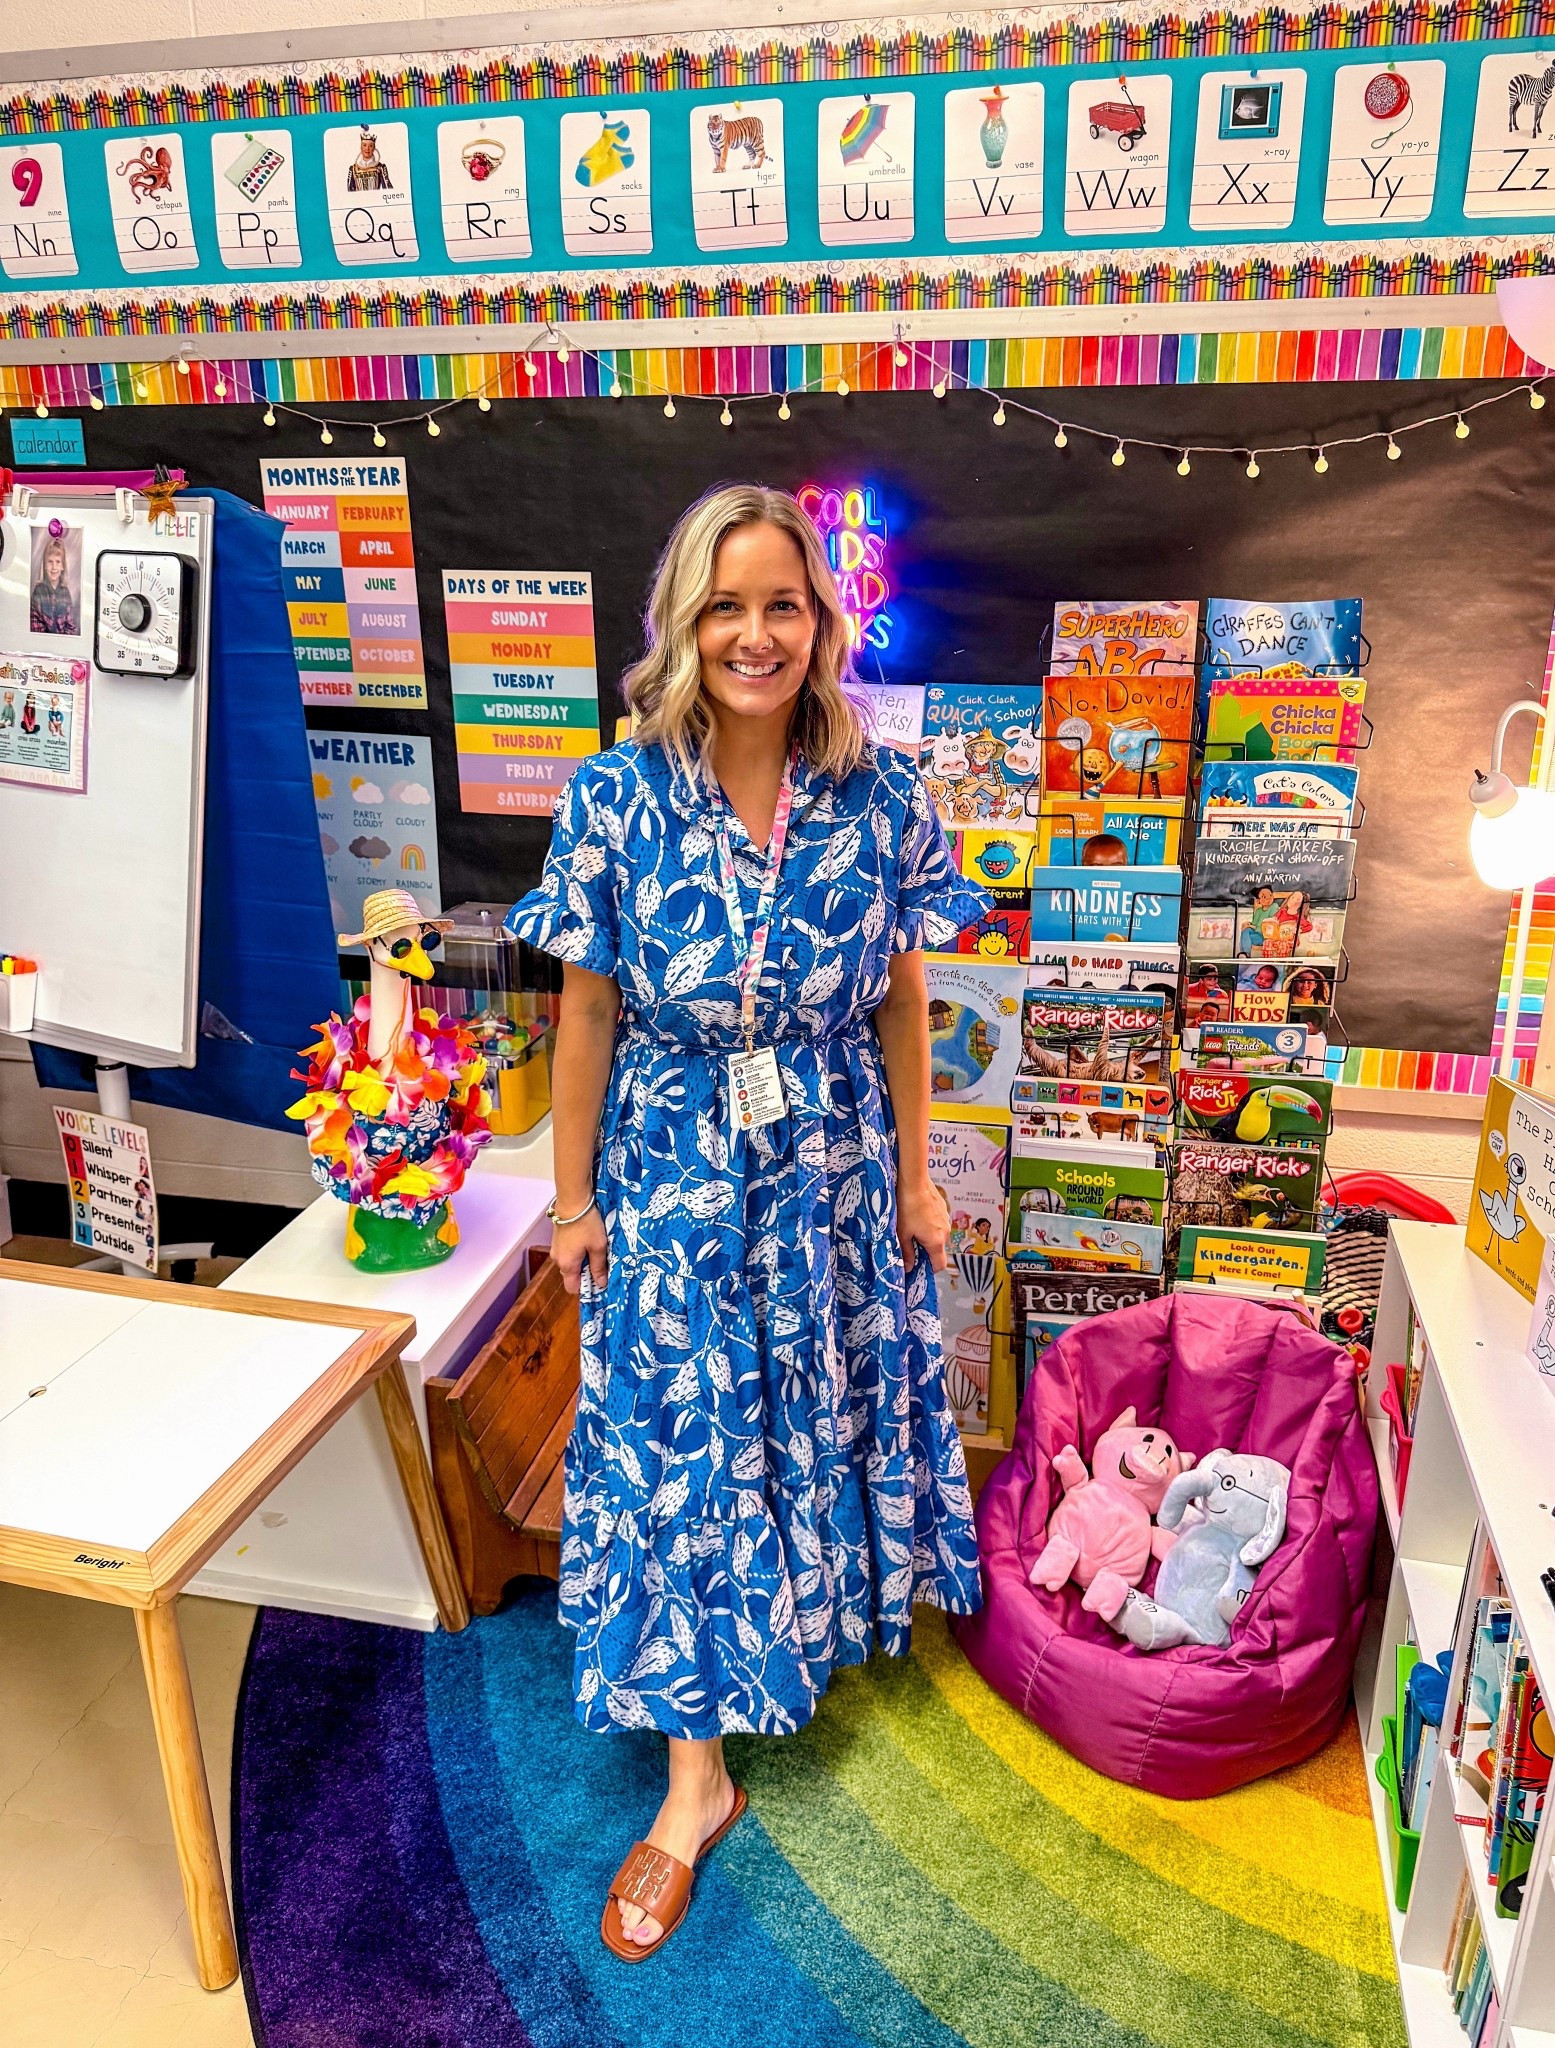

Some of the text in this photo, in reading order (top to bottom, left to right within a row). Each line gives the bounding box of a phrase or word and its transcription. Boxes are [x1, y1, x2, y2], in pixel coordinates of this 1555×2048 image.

[1401, 140, 1430, 151] yo-yo
[1129, 153, 1159, 164] wagon
[1264, 148, 1290, 159] x-ray
[869, 165, 906, 175] umbrella
[1015, 160, 1034, 170] vase
[1498, 149, 1549, 191] Zz
[756, 171, 777, 184] tiger
[1218, 164, 1269, 204] Xx
[505, 187, 520, 198] ring
[621, 181, 643, 190] socks
[1077, 169, 1156, 210] Ww
[1361, 157, 1403, 217] Yy
[268, 198, 289, 208] paints
[383, 192, 405, 203] queen
[844, 183, 890, 222] Uu
[973, 178, 1014, 217] Vv
[47, 209, 62, 217] nine
[156, 201, 183, 211] octopus
[721, 188, 760, 228] Tt
[465, 203, 506, 239] Rr
[588, 198, 626, 234] Ss
[14, 223, 56, 257] Nn
[133, 217, 178, 250] Oo
[238, 213, 278, 263] Pp
[345, 208, 405, 258] Qq
[18, 430, 78, 454] calendar
[267, 467, 401, 486] MONTHS OF THE YEAR
[273, 505, 329, 520] JANUARY
[343, 507, 404, 521] FEBRUARY
[798, 488, 881, 527] COOL
[156, 517, 196, 537] LILLIE
[285, 541, 325, 554] MARCH
[360, 541, 394, 555] APRIL
[829, 531, 884, 571] IDS
[107, 584, 114, 592] 50
[297, 576, 321, 590] MAY
[365, 578, 396, 591] JUNE
[448, 579, 587, 597] DAYS OF THE WEEK
[299, 612, 327, 626] JULY
[361, 613, 407, 628] AUGUST
[491, 611, 549, 628] SUNDAY
[1058, 611, 1189, 638] SUPERHERO
[1212, 612, 1335, 637] GIRAFFES CAN'T
[165, 636, 172, 644] 20
[1239, 636, 1308, 656] DANCE
[294, 647, 350, 661] EPTEMBER
[360, 649, 415, 662] OCTOBER
[492, 642, 552, 659] MONDAY
[1068, 640, 1166, 675] ABC
[493, 674, 554, 689] TUESDAY
[301, 682, 352, 697] OVEMBER
[359, 684, 422, 698] DECEMBER
[483, 703, 569, 720] WEDNESDAY
[1049, 690, 1098, 722] No,
[1272, 705, 1336, 719] Chicka
[927, 705, 987, 726] QUACK
[1270, 721, 1334, 734] Chicka
[492, 733, 564, 751] THURSDAY
[311, 738, 415, 766] WEATHER
[506, 763, 554, 779] FRIDAY
[1264, 776, 1335, 806] Cat's Colors
[498, 792, 557, 808] SATURDA
[354, 810, 381, 819] PARTLY
[354, 819, 383, 828] CLOUDY
[396, 818, 425, 827] CLOUDY
[1106, 817, 1122, 828] All
[1270, 822, 1294, 832] WAS
[1220, 840, 1333, 855] RACHEL PARKER,
[1205, 853, 1344, 865] KINDERGARTEN SHOW-OFF
[358, 877, 386, 886] STORMY
[396, 879, 433, 889] RAINBOW
[1243, 873, 1300, 884] ANN MARTIN
[1051, 889, 1162, 916] KINDNESS
[1102, 916, 1120, 926] WITH
[1044, 954, 1067, 964] CAN
[1092, 958, 1123, 969] HARD
[1243, 993, 1275, 1004] How
[1030, 1005, 1147, 1030] Ranger Rick
[1234, 1007, 1285, 1023] KIDS
[1226, 1040, 1260, 1052] friends
[1283, 1036, 1294, 1046] 3
[1194, 1077, 1222, 1085] Ranger
[1189, 1085, 1222, 1100] Rick
[1516, 1110, 1540, 1137] The
[55, 1110, 146, 1153] VOICE LEVELS
[1020, 1128, 1038, 1137] my
[82, 1139, 112, 1159] Silent
[1179, 1152, 1300, 1178] Ranger Rick
[86, 1162, 132, 1186] Whisper
[1056, 1169, 1116, 1188] Schools
[74, 1181, 134, 1208] 2 Partner
[1067, 1185, 1104, 1196] AROUND
[1078, 1196, 1103, 1204] WORLD
[77, 1203, 147, 1236] 3 Presenter
[77, 1226, 135, 1254] 4 Outside
[1230, 1243, 1275, 1255] Look Out
[1200, 1250, 1304, 1270] Kindergarten,
[1219, 1265, 1242, 1275] Here
[1251, 1269, 1281, 1279] Come!
[1022, 1285, 1148, 1312] Perfect
